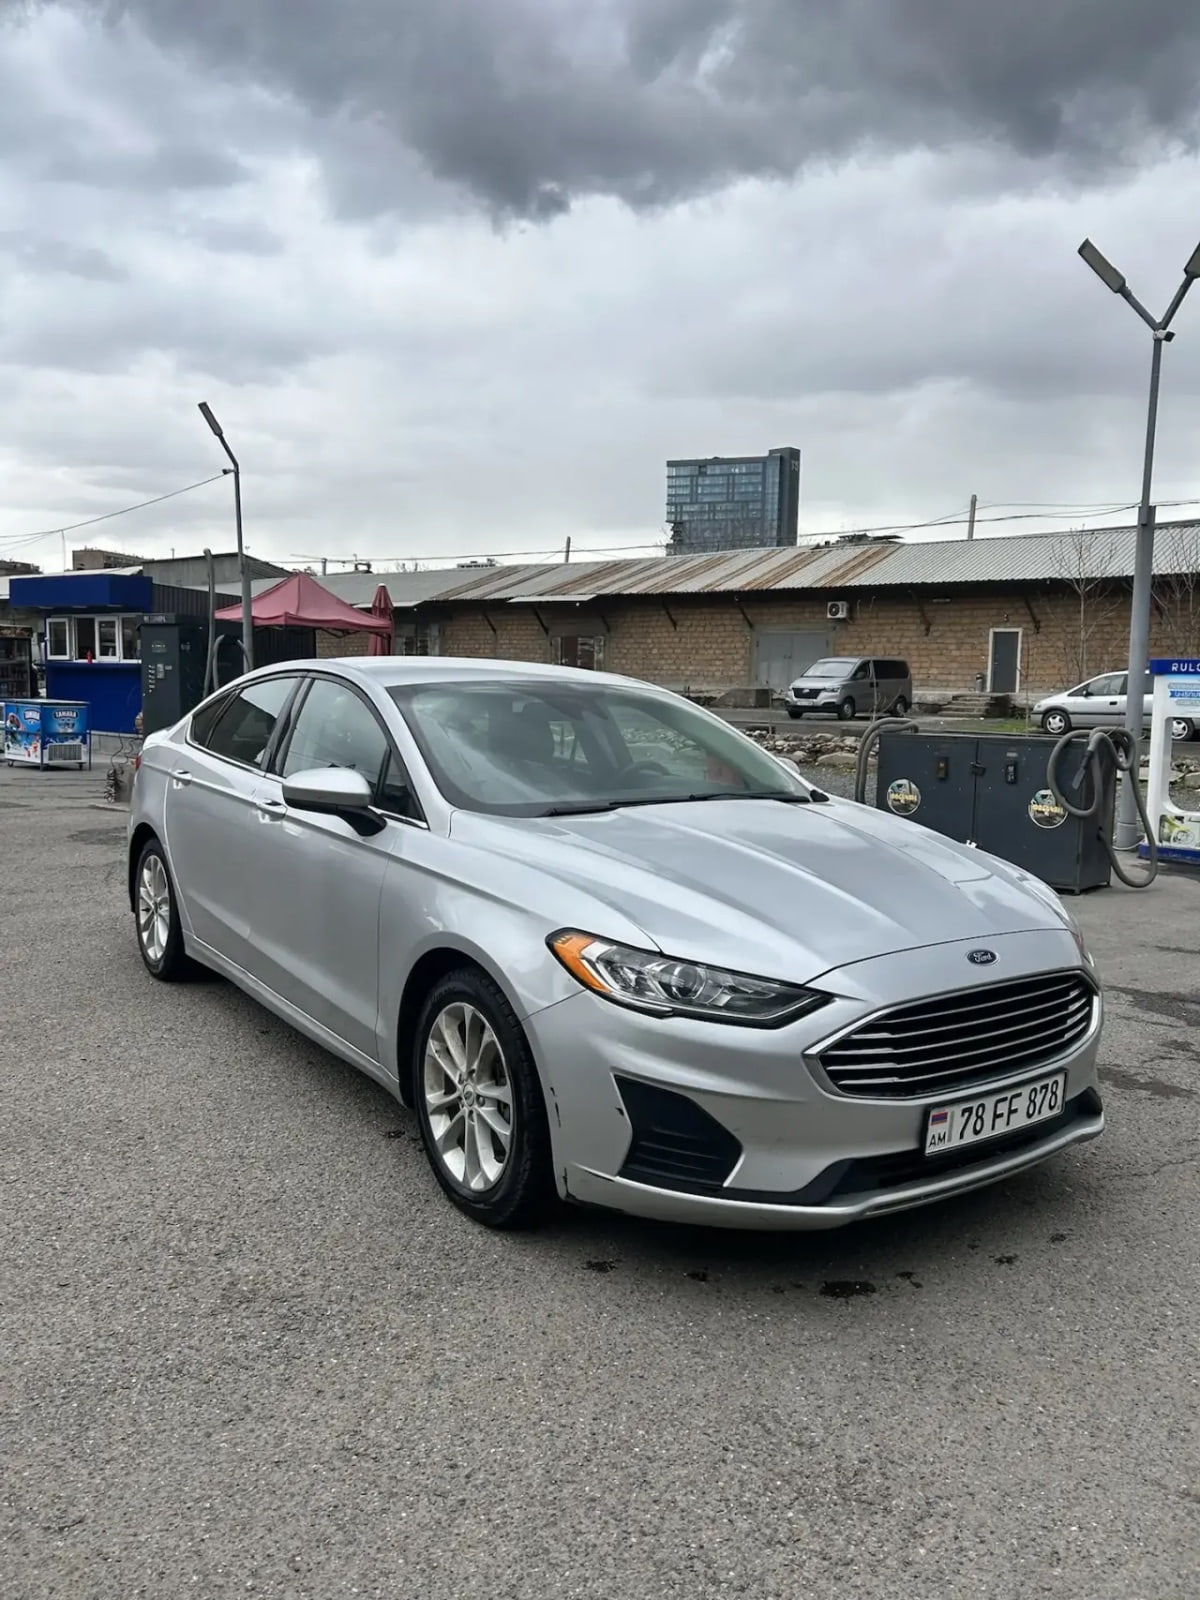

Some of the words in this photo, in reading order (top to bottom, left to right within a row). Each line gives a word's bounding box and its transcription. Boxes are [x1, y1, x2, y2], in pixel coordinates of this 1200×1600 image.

[973, 951, 993, 963] Ford
[959, 1102, 986, 1140] 78
[991, 1092, 1022, 1131] FF
[1026, 1080, 1059, 1119] 878
[928, 1131, 947, 1148] AM
